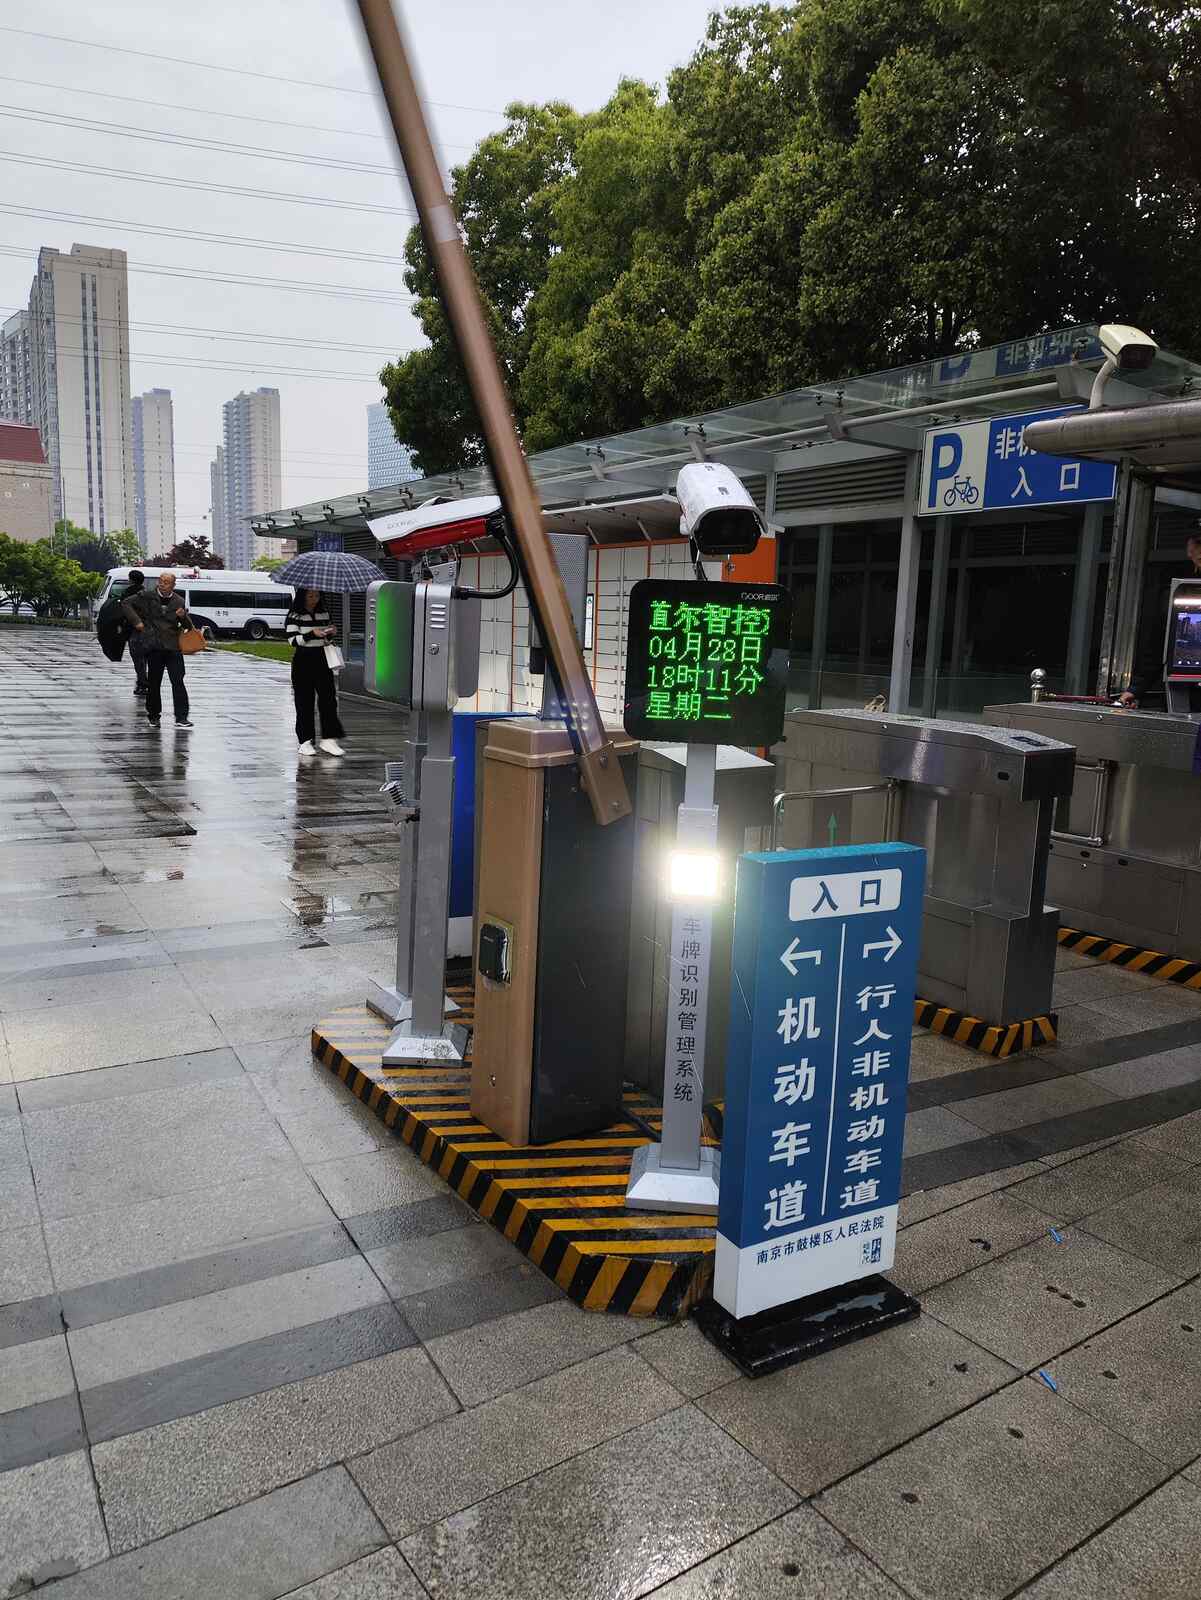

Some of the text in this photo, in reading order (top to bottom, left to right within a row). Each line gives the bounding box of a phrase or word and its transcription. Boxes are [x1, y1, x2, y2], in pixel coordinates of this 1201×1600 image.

[927, 432, 963, 509] P
[1010, 463, 1081, 499] 入口
[649, 632, 762, 663] 04月28日
[648, 663, 764, 695] 18时11分
[646, 691, 732, 720] 星期二
[811, 878, 882, 914] 入口
[673, 917, 703, 1102] 车牌识别管理系统
[763, 997, 821, 1232] 机动车道
[840, 984, 897, 1210] 行人非机动车道
[757, 1215, 885, 1265] 南京市鼓楼区人民法院
